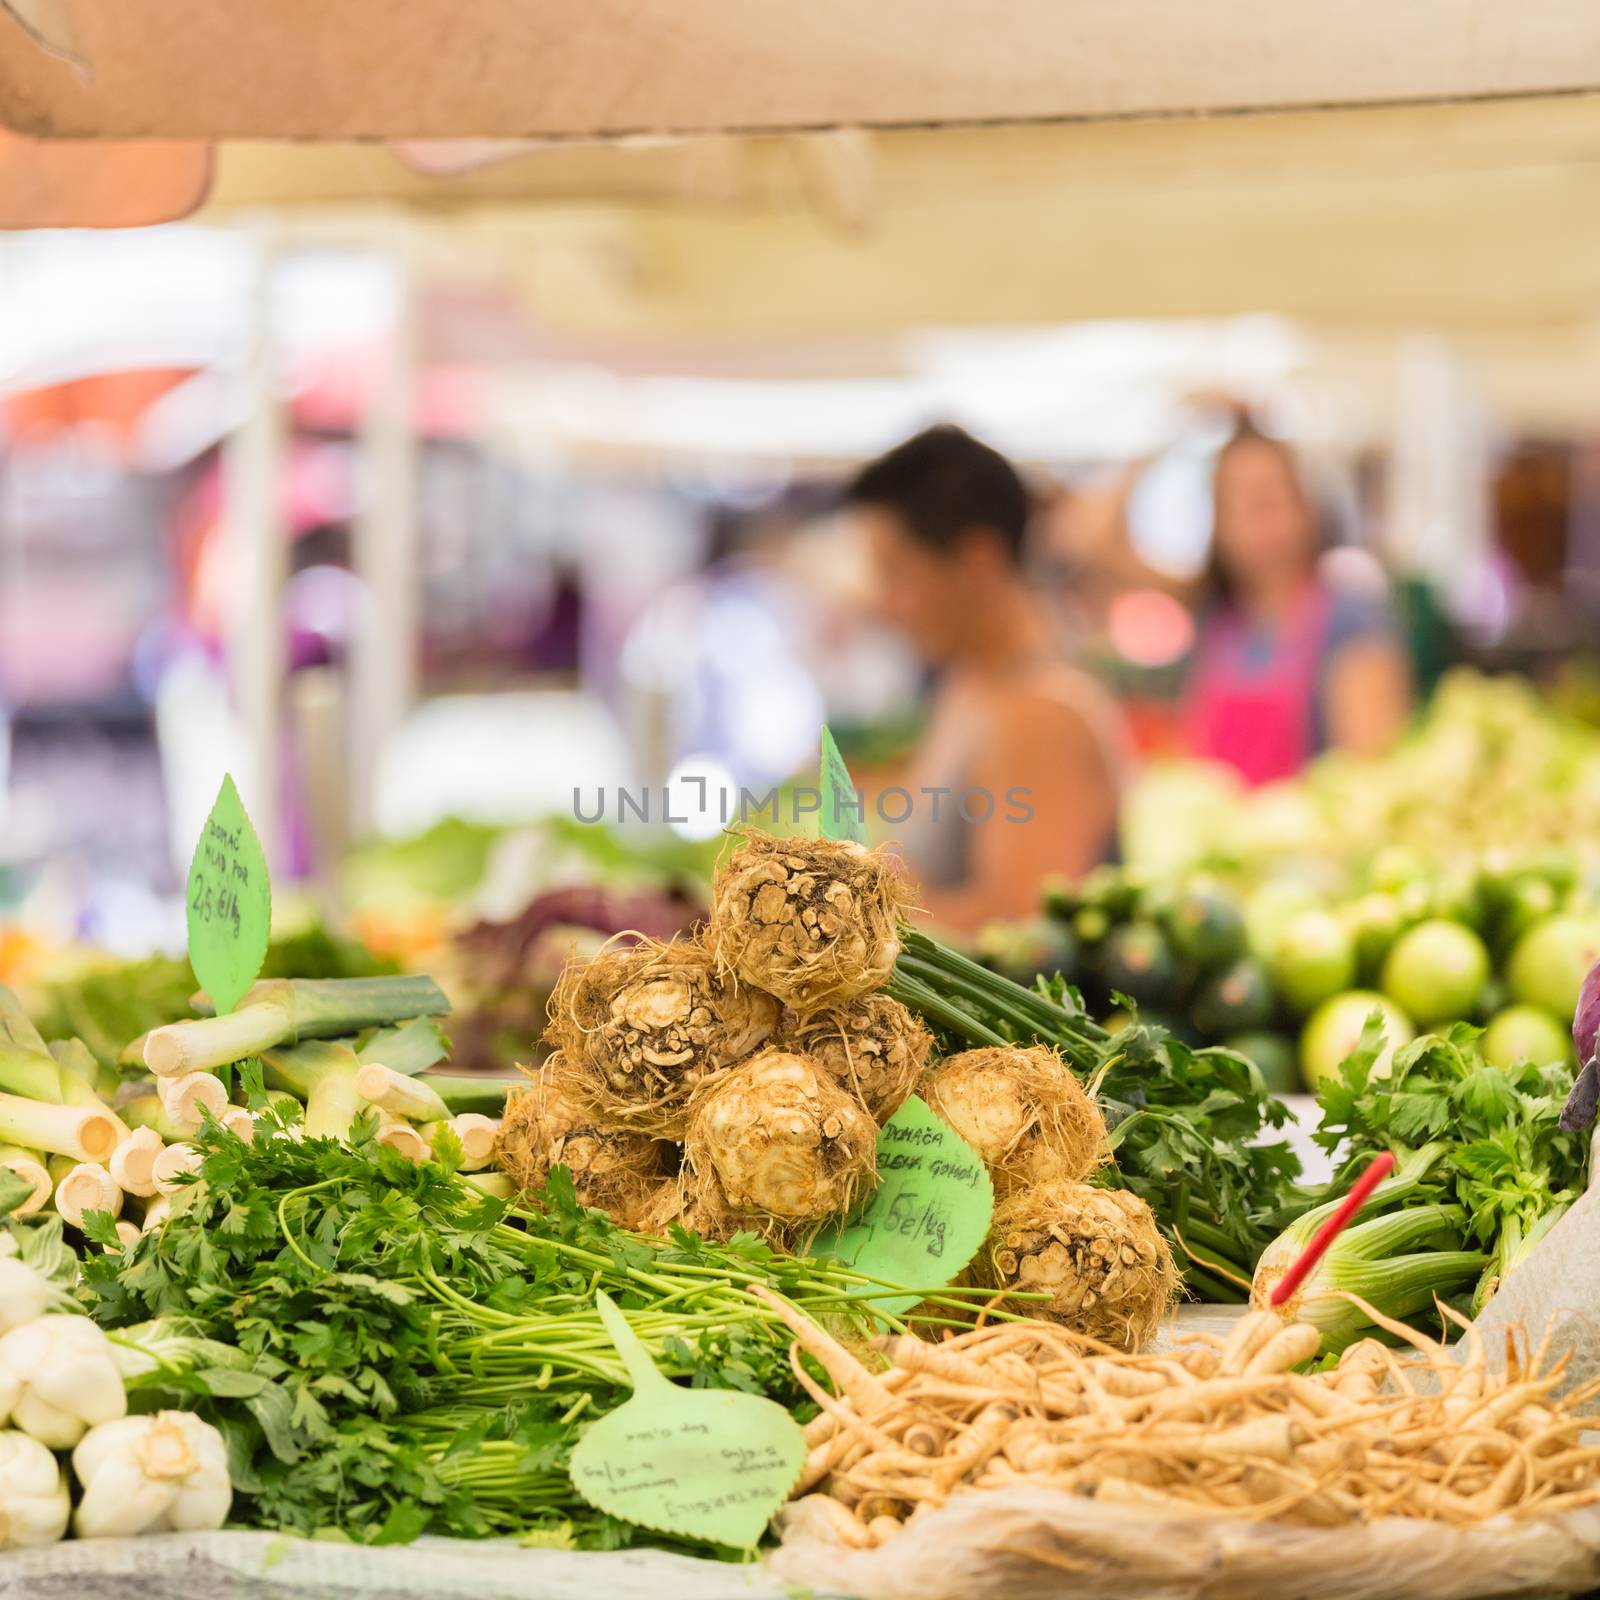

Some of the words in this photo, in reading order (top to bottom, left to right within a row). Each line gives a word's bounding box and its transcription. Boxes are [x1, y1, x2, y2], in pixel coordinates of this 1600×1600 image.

[210, 819, 242, 852] DOMAČ
[232, 859, 248, 888] POR
[884, 1122, 944, 1147] DOMAČA
[876, 1152, 922, 1171] ELENA
